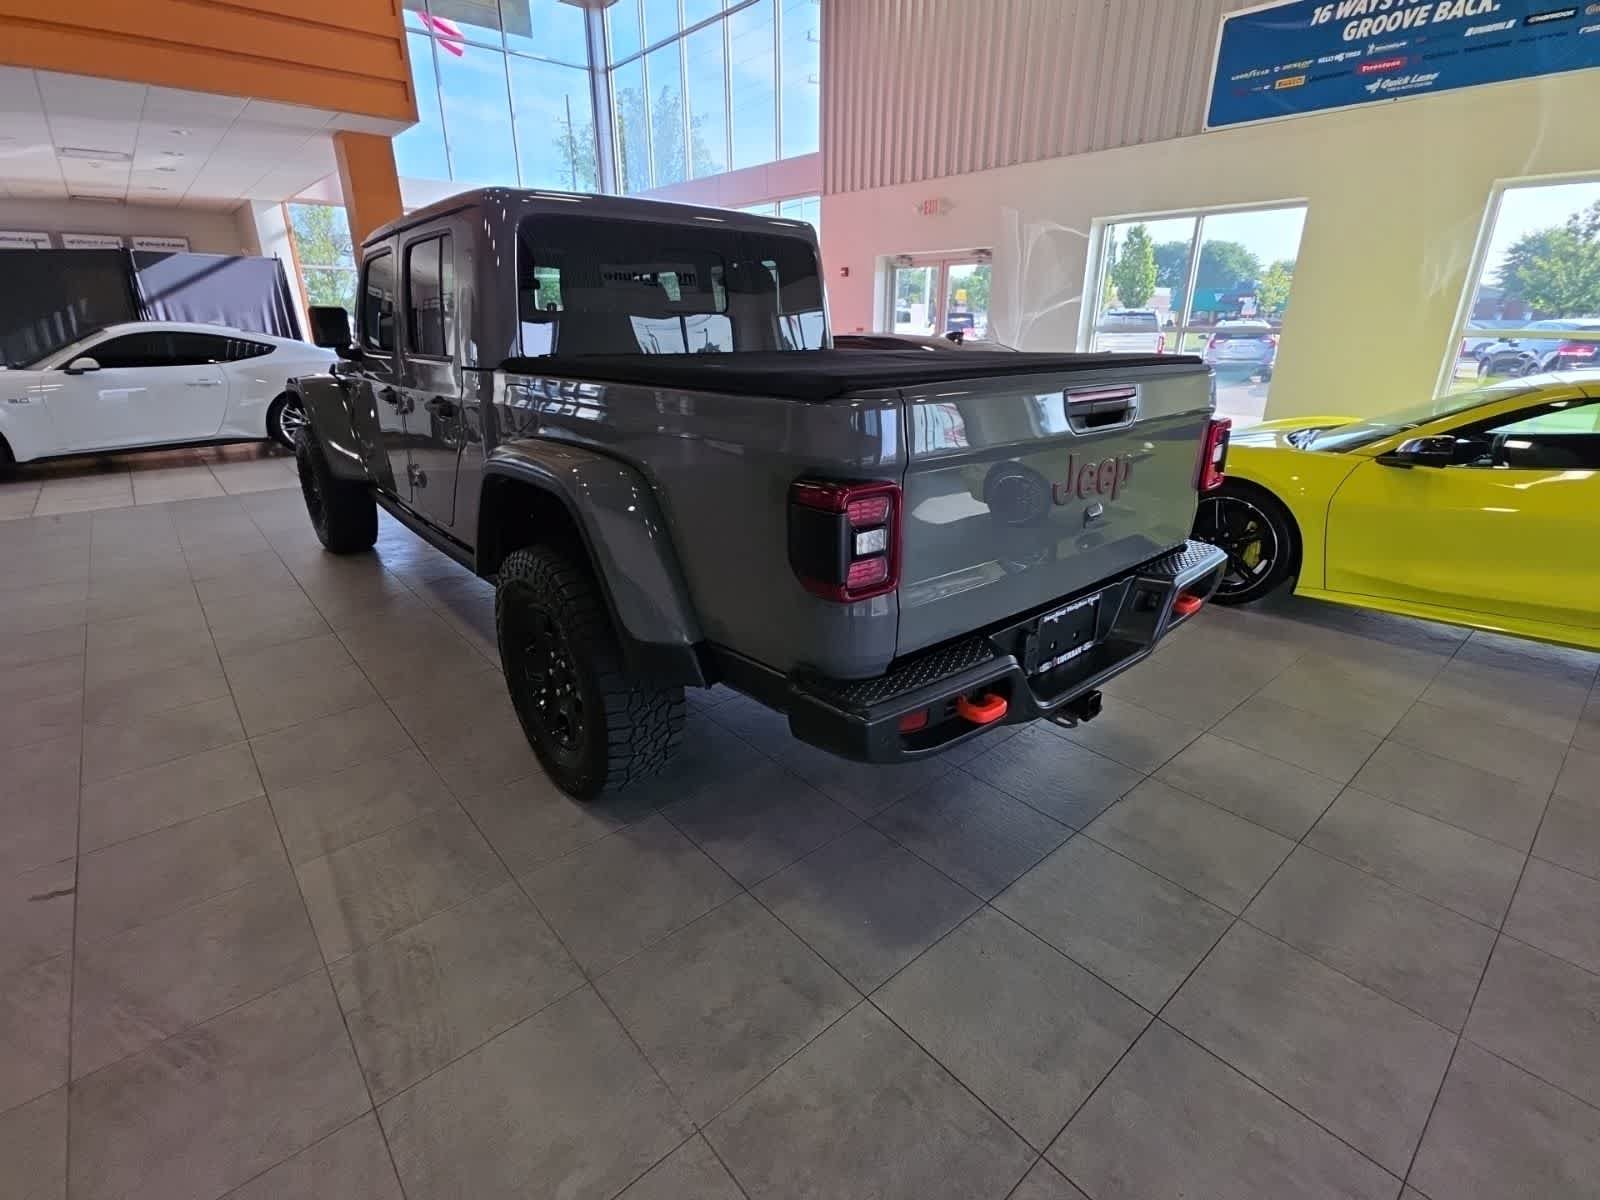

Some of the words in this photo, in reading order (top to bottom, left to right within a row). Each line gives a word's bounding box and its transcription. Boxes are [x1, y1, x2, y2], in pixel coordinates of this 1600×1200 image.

[1310, 4, 1334, 27] 16
[1336, 0, 1393, 20] WAYS
[1342, 4, 1433, 41] GROOVE
[1380, 75, 1411, 89] Quick
[1053, 451, 1132, 506] Jeep
